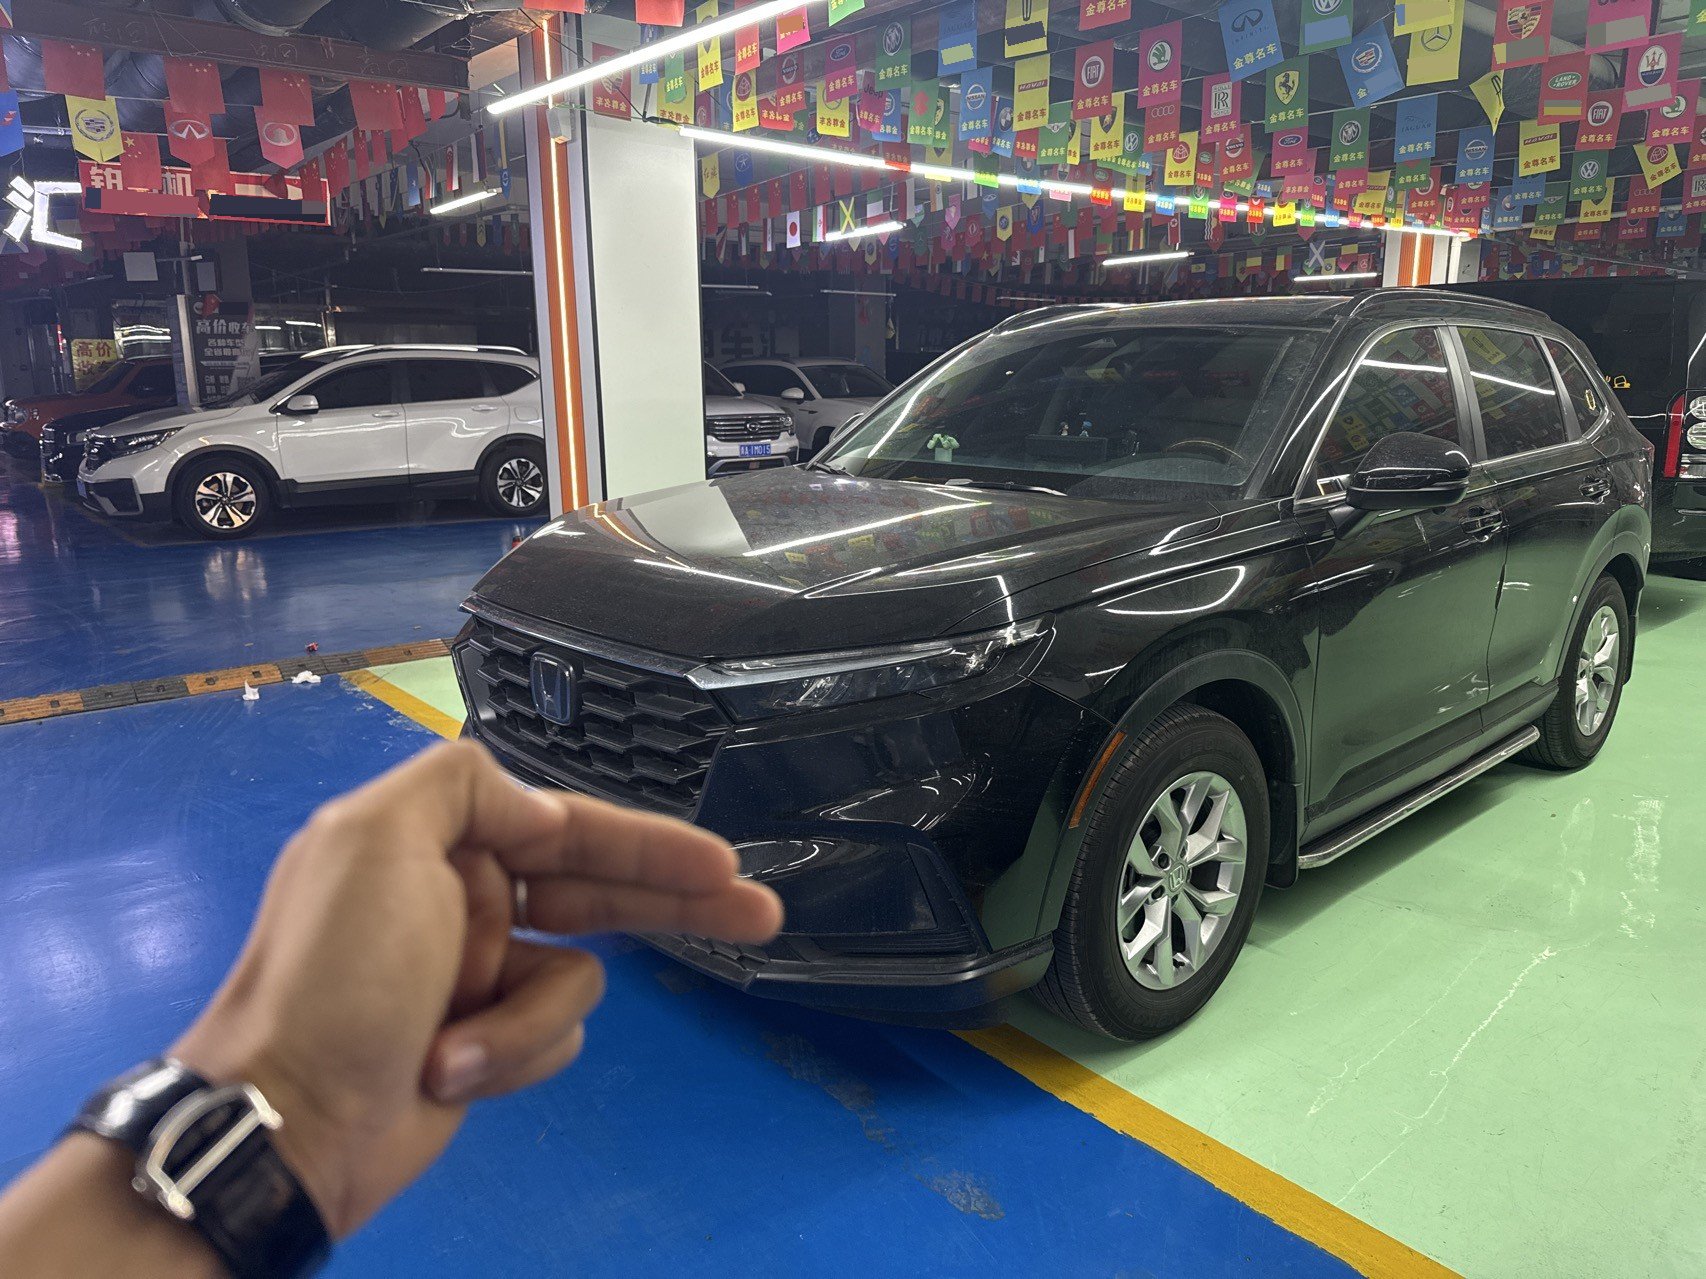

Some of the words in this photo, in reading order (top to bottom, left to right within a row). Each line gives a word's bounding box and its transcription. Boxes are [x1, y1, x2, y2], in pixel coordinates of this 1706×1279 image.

[1233, 43, 1278, 70] 金尊名车
[879, 64, 908, 80] 金尊名车
[1142, 79, 1179, 97] 金尊名车
[1077, 95, 1109, 110] 金尊名车
[1017, 109, 1047, 122] 金尊名车
[1269, 107, 1305, 125] 金尊名车
[1592, 108, 1607, 120] FIAT
[961, 119, 989, 131] 金尊名车
[1205, 120, 1237, 135] 金尊名车
[1147, 130, 1177, 144] 金尊名车
[1580, 133, 1613, 144] 金尊名车
[1651, 126, 1690, 139] 金尊名车
[1398, 142, 1432, 154] 金尊名车
[1333, 151, 1365, 163] 金尊名车
[1523, 155, 1557, 169] 金尊名车
[1275, 158, 1304, 170] 金尊名车
[1459, 166, 1490, 178] 金尊名车
[1573, 184, 1603, 195] 金尊名车
[2, 175, 83, 252] 汇
[76, 341, 112, 358] 高价
